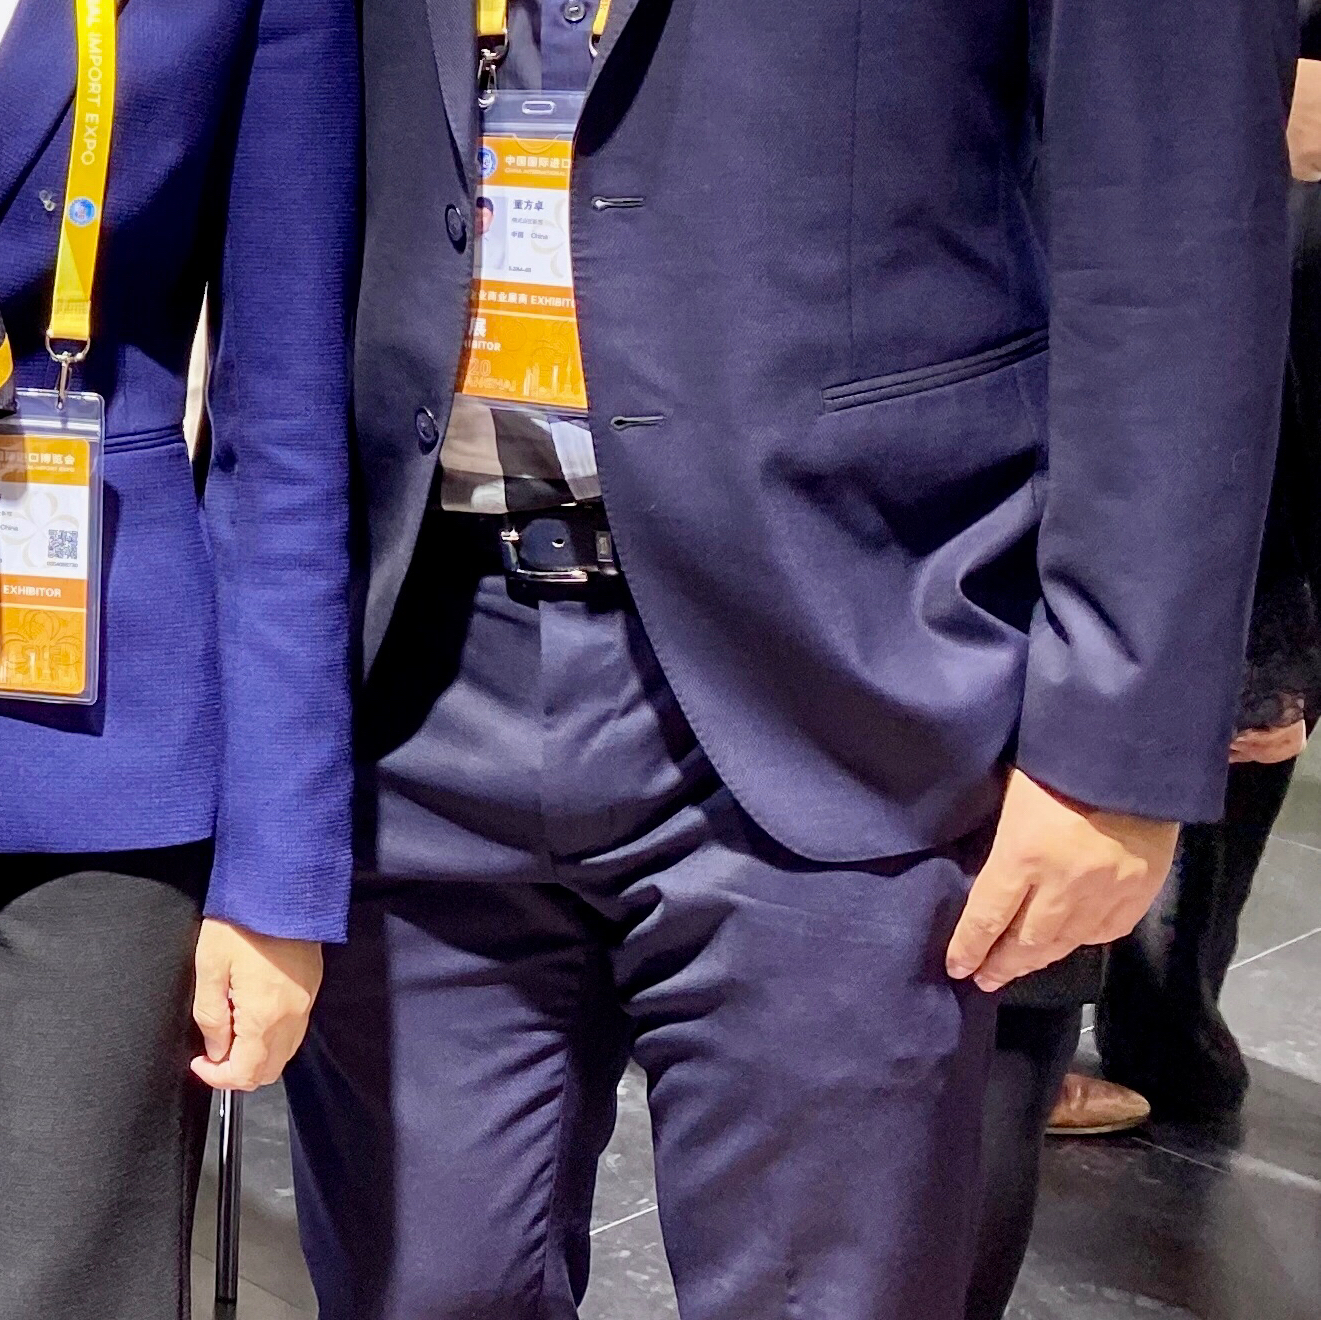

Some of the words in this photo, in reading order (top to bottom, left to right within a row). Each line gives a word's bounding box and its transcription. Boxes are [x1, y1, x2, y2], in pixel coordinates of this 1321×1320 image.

[87, 32, 103, 107] IMPORT
[80, 112, 100, 166] EXPO
[505, 154, 571, 169] 中国国际进口
[3, 584, 62, 598] EXHIBITOR
